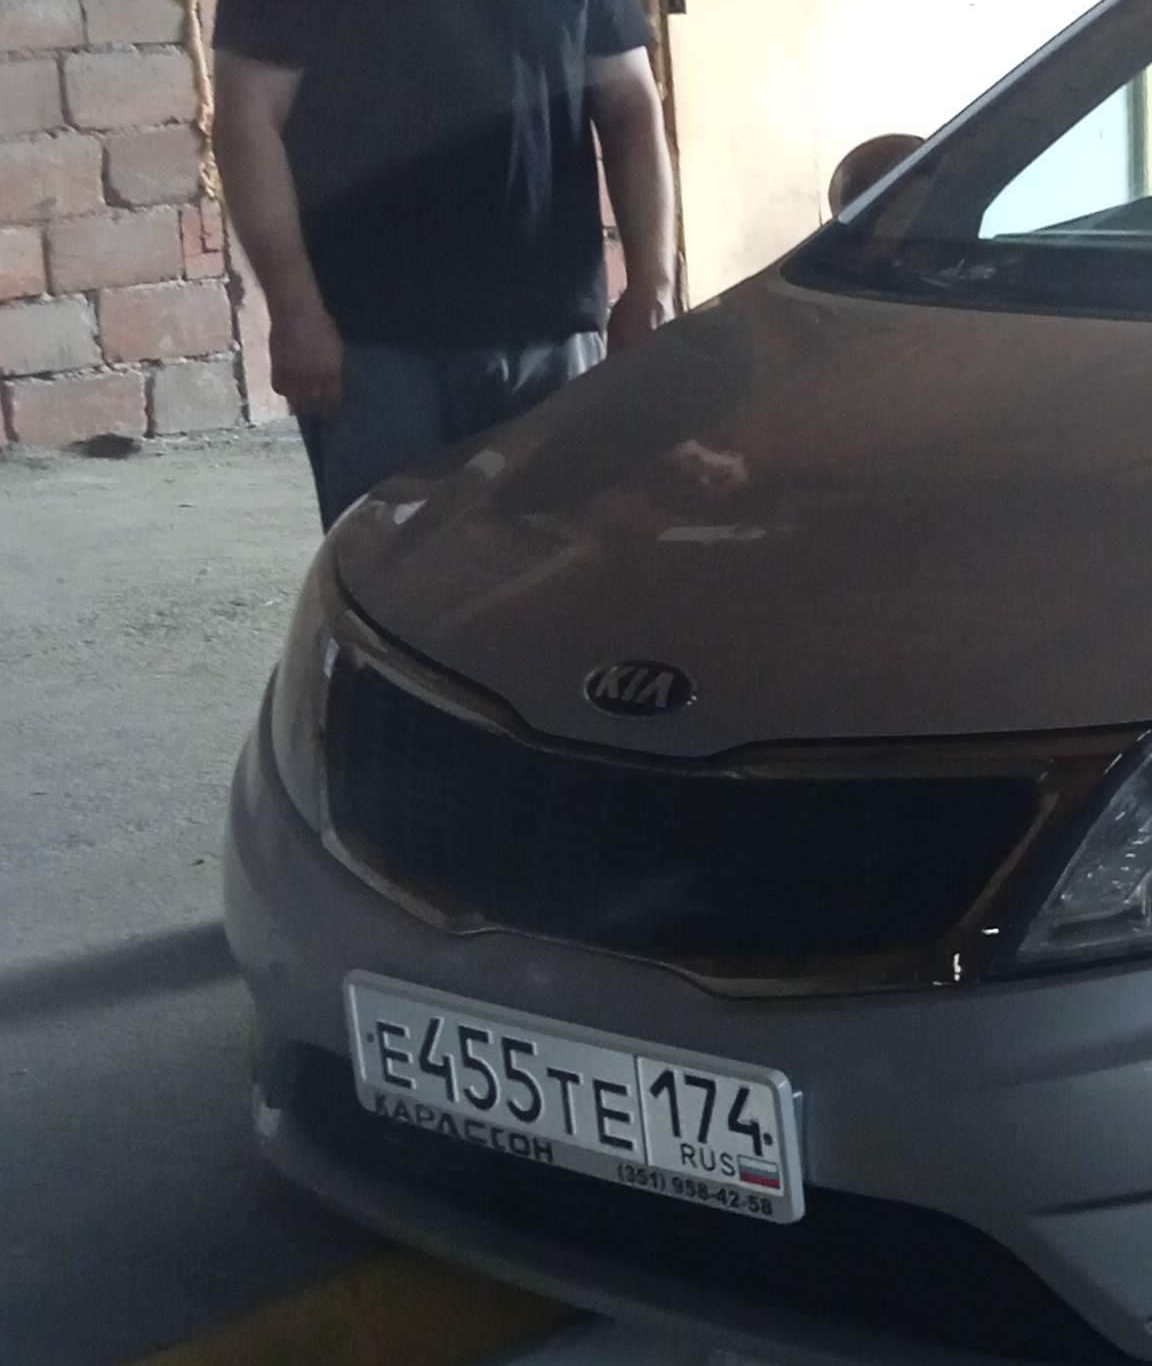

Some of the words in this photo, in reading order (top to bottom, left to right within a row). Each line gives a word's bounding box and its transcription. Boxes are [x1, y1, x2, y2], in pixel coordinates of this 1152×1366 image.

[595, 665, 674, 708] KIA
[649, 1069, 764, 1156] 174
[680, 1143, 736, 1177] RUS
